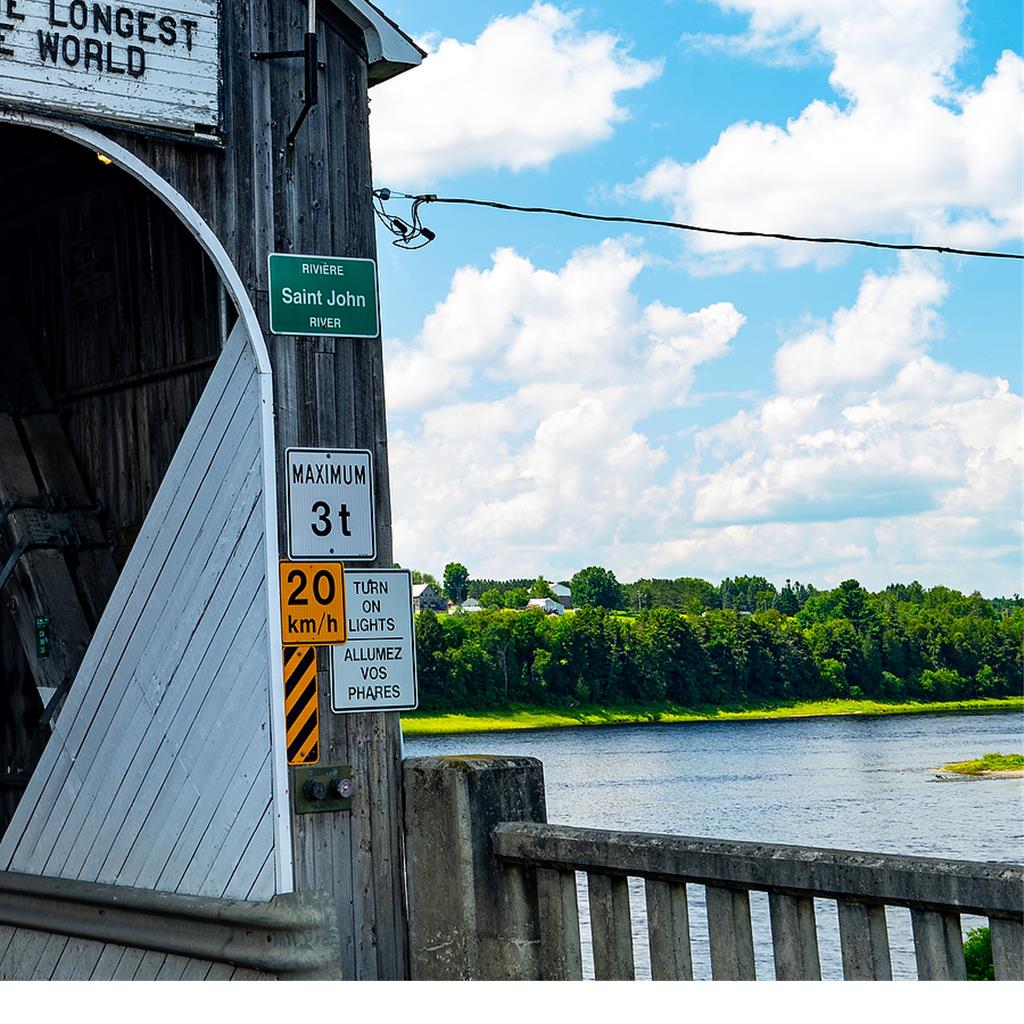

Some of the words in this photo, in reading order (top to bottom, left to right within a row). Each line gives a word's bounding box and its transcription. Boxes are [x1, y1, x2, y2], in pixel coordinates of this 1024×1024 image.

[38, 29, 145, 77] WORLD
[302, 261, 344, 275] RIVIÈRE
[282, 288, 322, 305] Saint
[327, 290, 365, 307] John
[310, 317, 341, 328] RIVER
[293, 464, 365, 485] MAXIMUM
[311, 501, 331, 536] 3
[339, 504, 351, 536] t
[288, 570, 335, 605] 20
[354, 581, 388, 595] TURN
[362, 600, 381, 613] ON
[288, 612, 337, 635] km/h
[349, 618, 395, 632] LIGHTS
[344, 647, 402, 662] ALLUMEZ
[361, 667, 387, 680] VOS
[349, 685, 400, 700] PHARES
